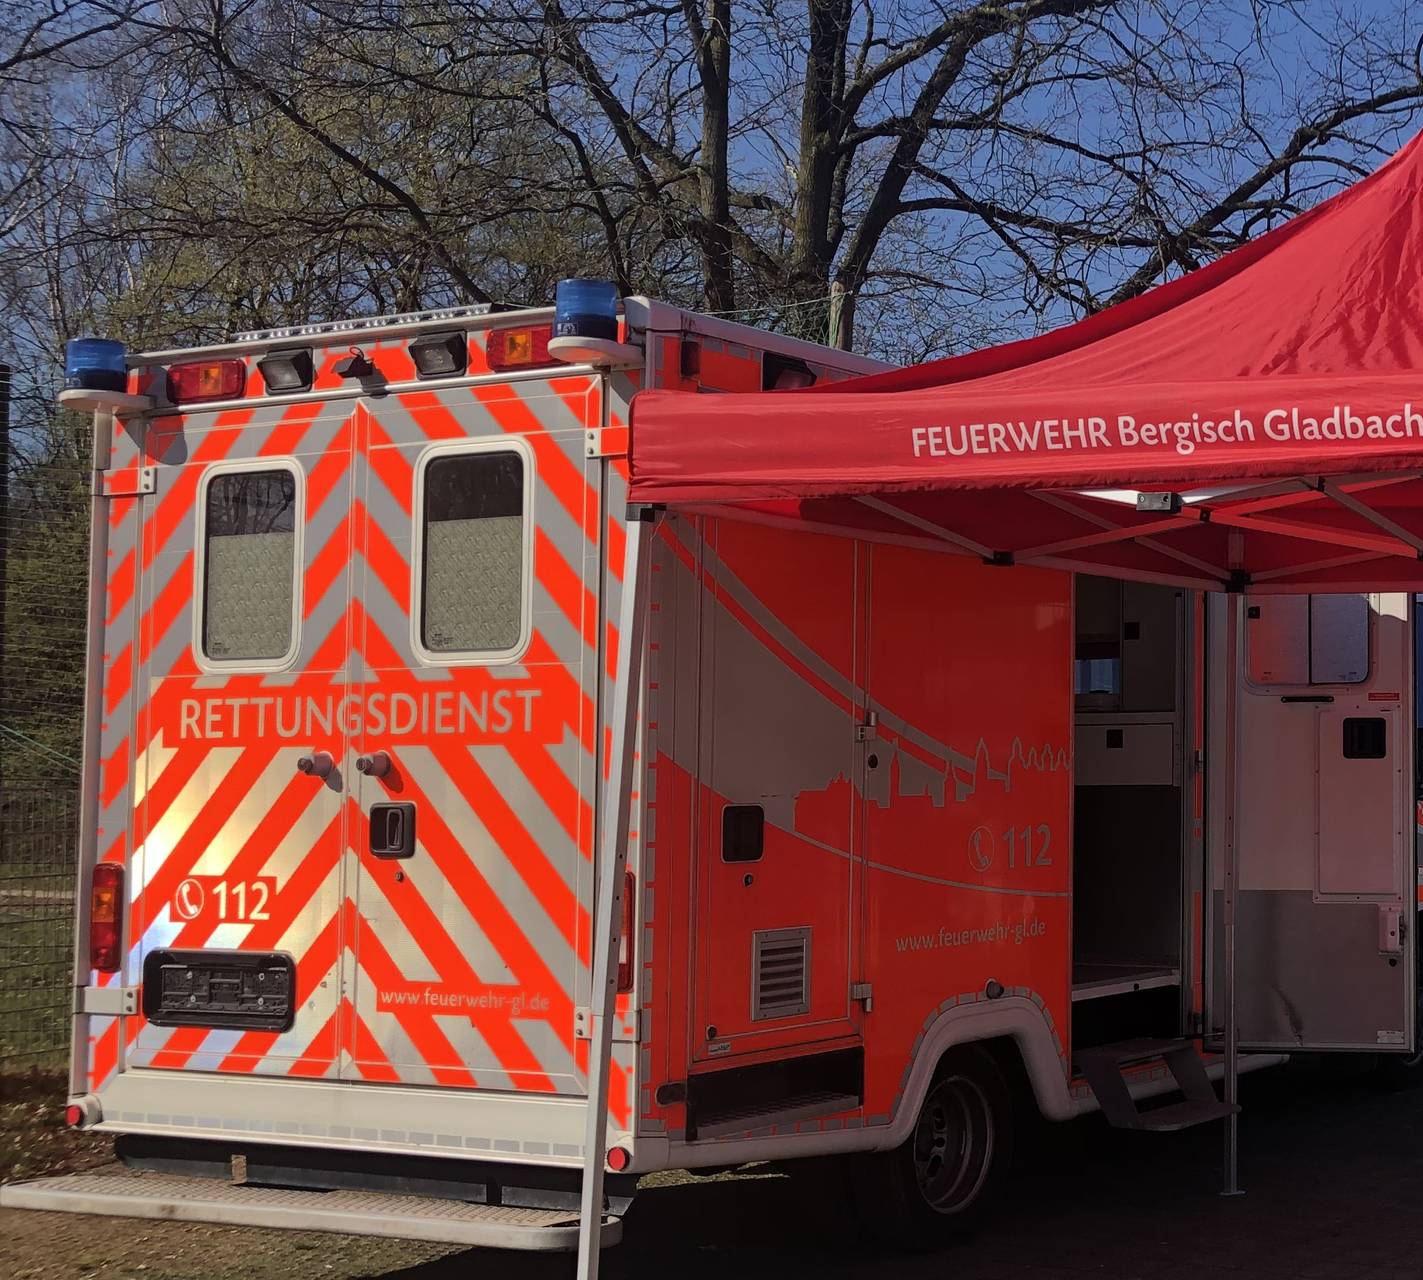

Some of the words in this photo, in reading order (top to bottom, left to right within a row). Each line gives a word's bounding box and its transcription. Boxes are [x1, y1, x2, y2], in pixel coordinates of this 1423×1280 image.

[912, 416, 1112, 457] FEUERWEHR
[1119, 409, 1255, 455] Bergisch
[179, 689, 542, 739] RETTUNGSDIENST
[1003, 824, 1053, 868] 112
[212, 880, 271, 920] 112
[895, 917, 1047, 953] www.feuerwehr-gl.de
[380, 986, 549, 1016] www.feuerwehr-gl.de
